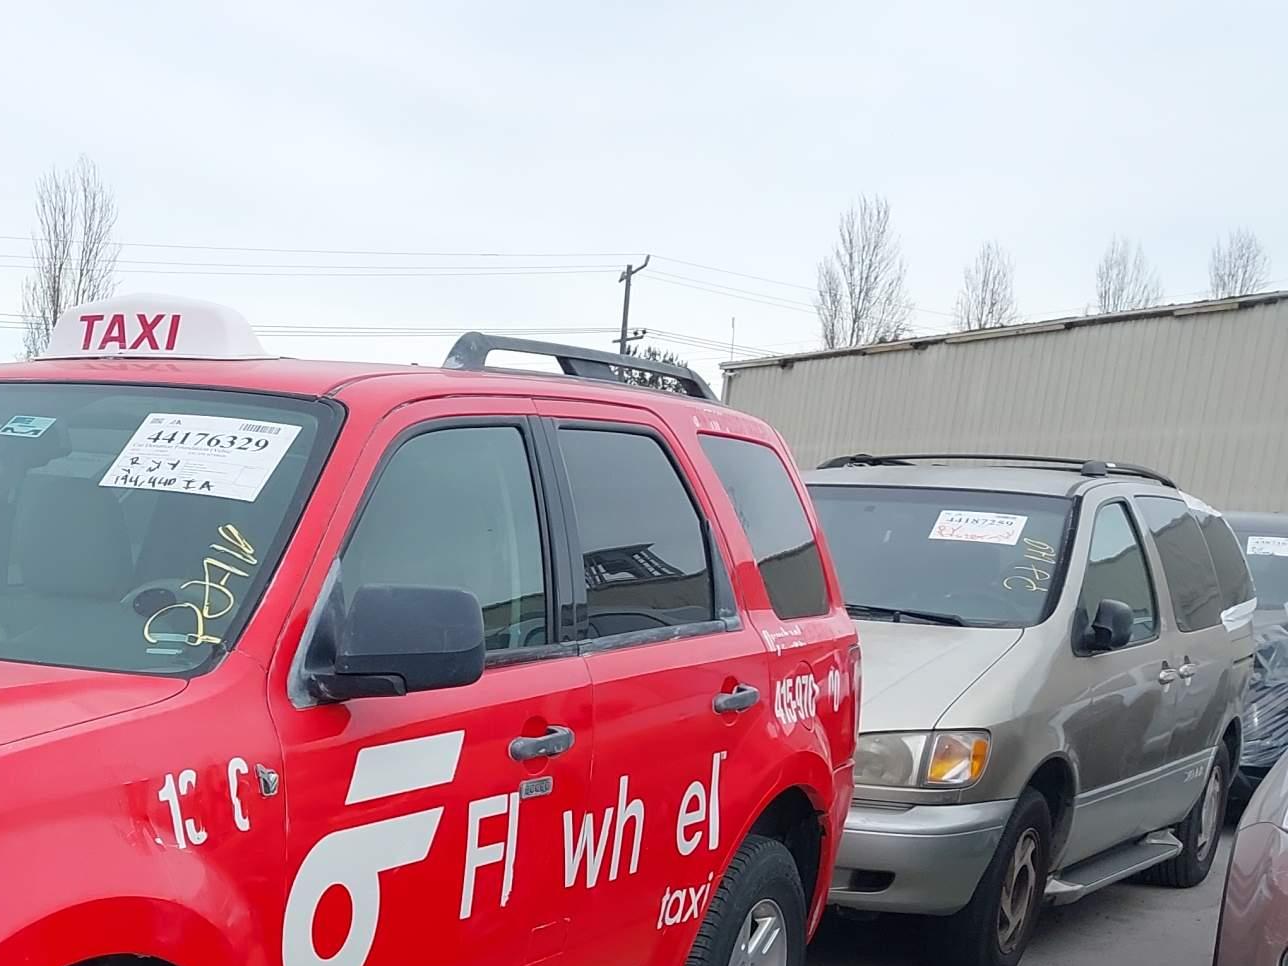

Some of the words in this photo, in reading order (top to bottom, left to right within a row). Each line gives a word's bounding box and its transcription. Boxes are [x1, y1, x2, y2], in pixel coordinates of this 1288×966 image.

[79, 313, 181, 350] TAXI
[147, 430, 270, 452] 44176329
[656, 871, 715, 930] taxi
